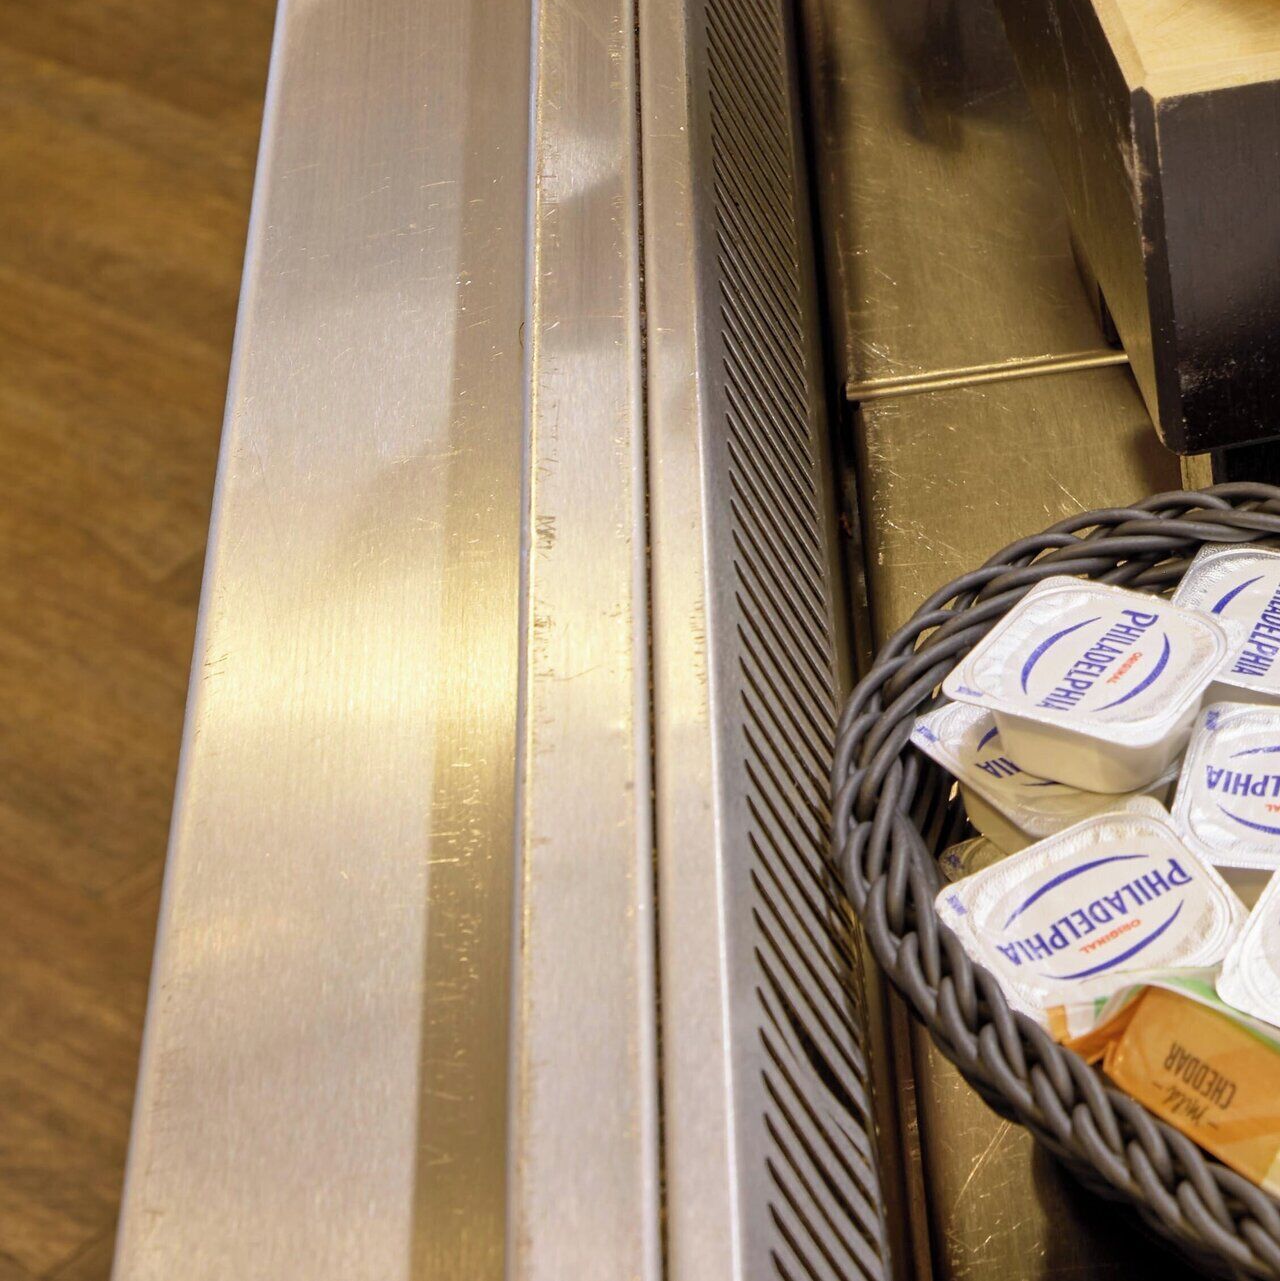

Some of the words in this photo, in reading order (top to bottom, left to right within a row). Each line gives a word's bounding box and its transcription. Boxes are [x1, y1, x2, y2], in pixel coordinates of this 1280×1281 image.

[1035, 608, 1160, 712] PHILADELPHIA
[1106, 651, 1144, 685] ORIGINAL
[996, 858, 1194, 967] PHILADELPHIA
[1079, 918, 1142, 954] ORIGINAL
[1162, 1041, 1238, 1112] CHEDDAR
[1163, 1084, 1208, 1129] mild
